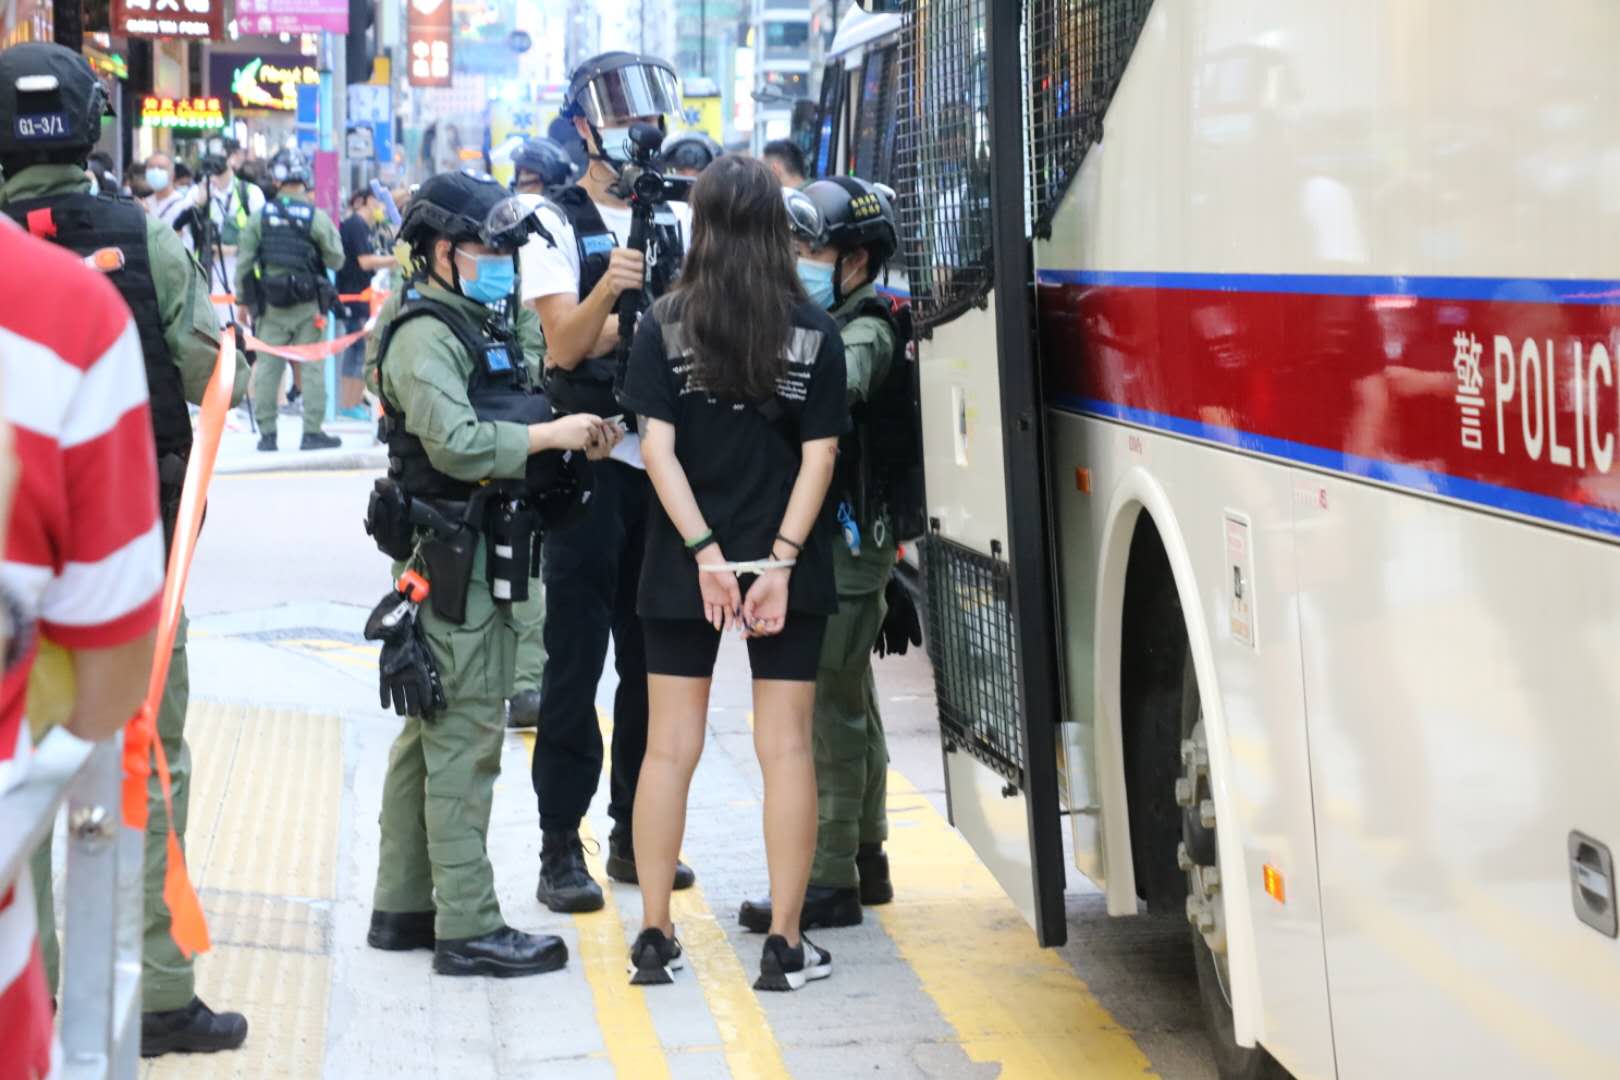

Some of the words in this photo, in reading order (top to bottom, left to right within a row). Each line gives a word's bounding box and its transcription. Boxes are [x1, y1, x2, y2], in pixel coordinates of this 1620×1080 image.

[19, 116, 64, 136] G1-3/1
[1453, 330, 1485, 450] 警
[1494, 335, 1620, 474] POLIC
